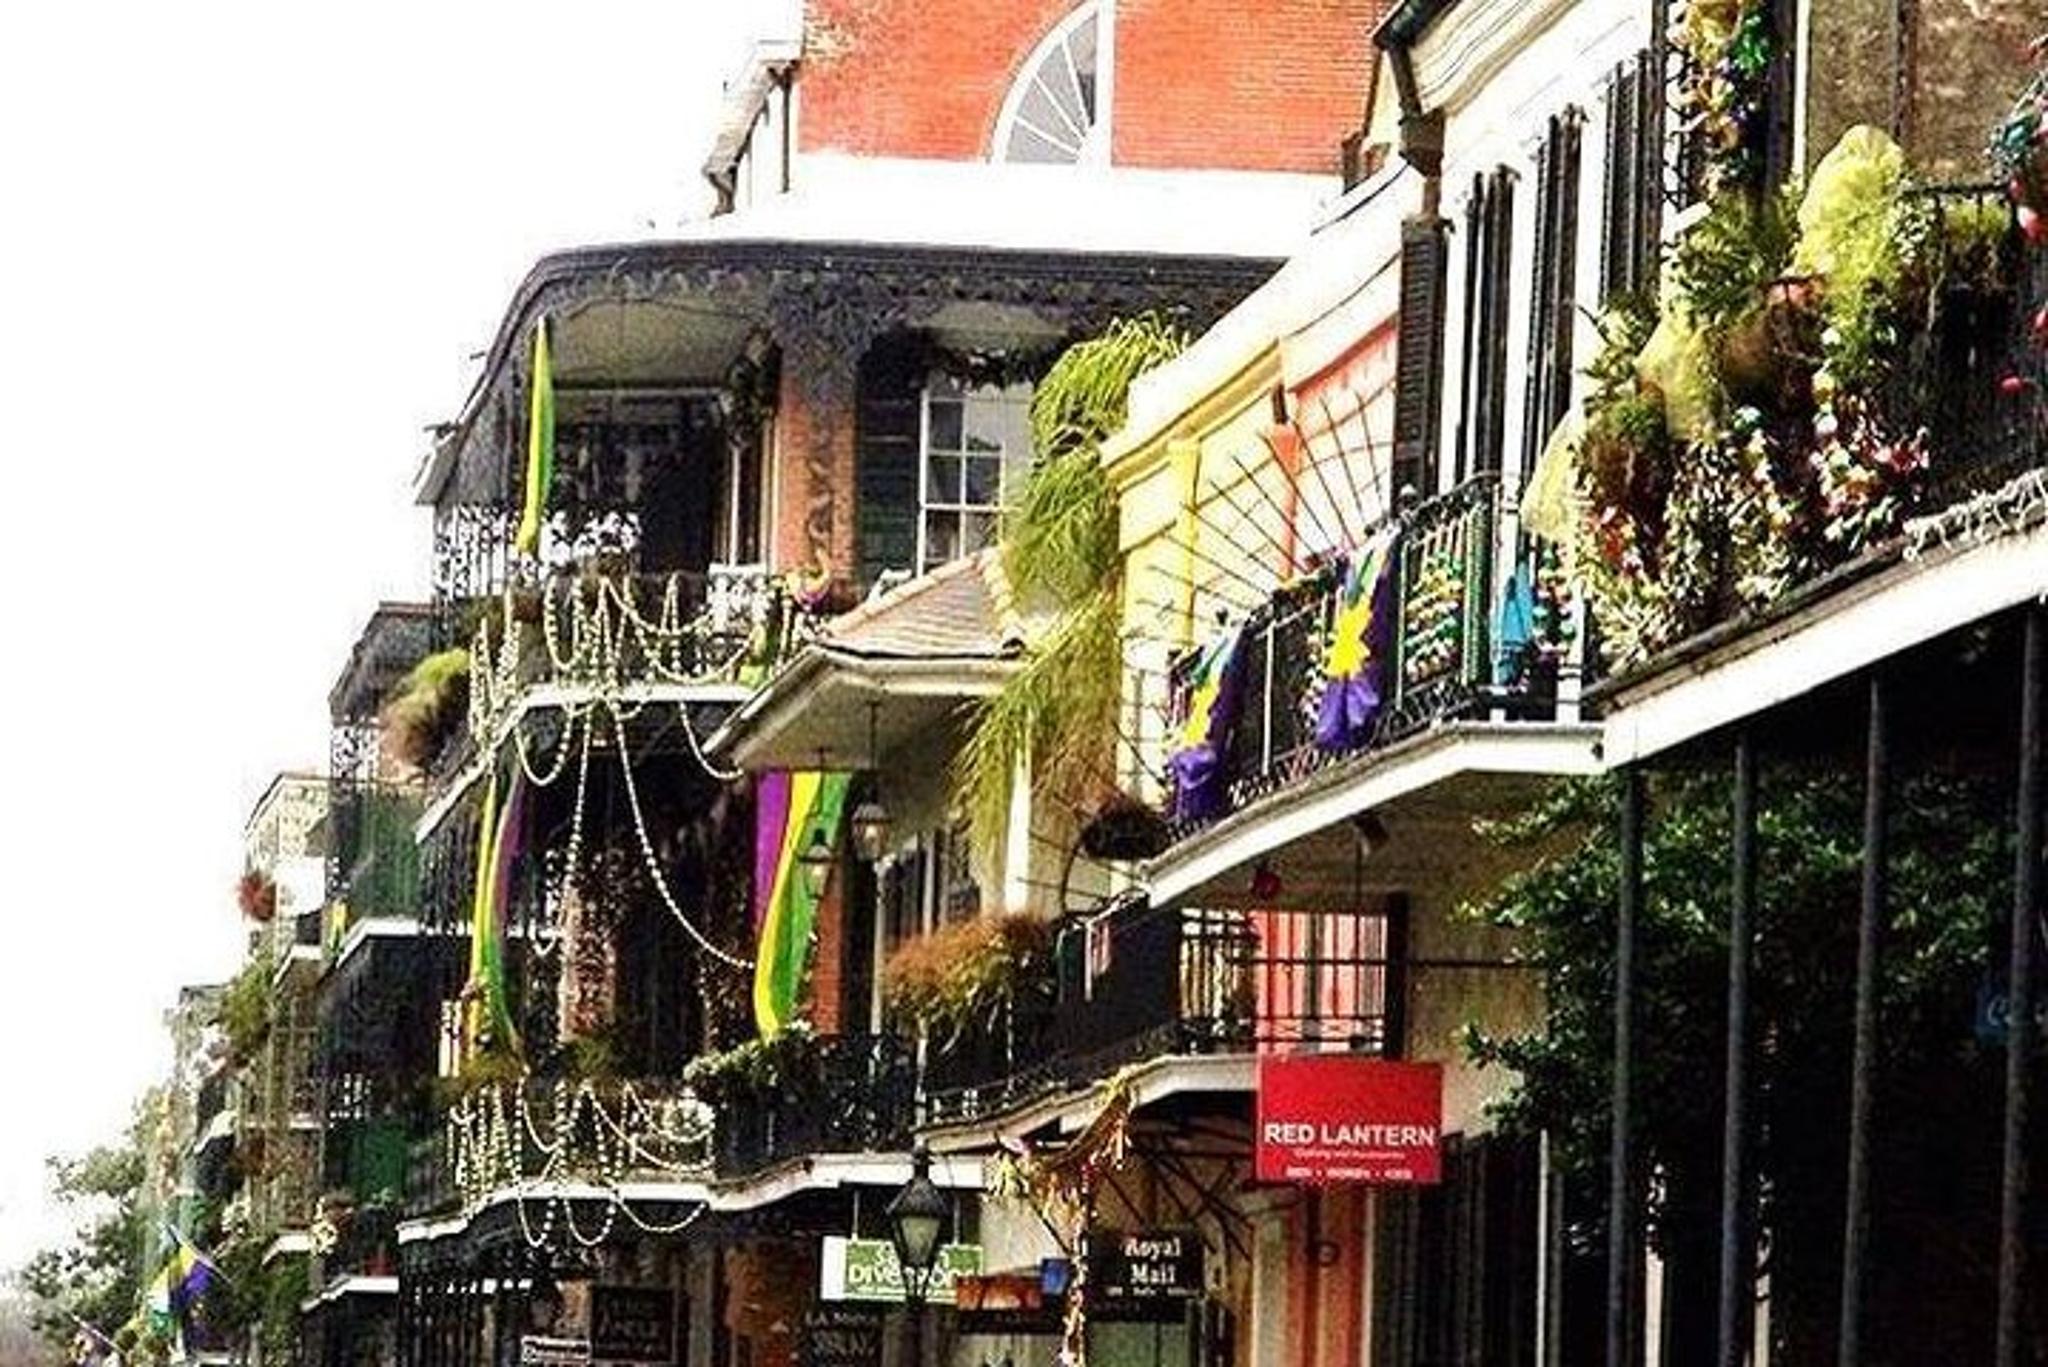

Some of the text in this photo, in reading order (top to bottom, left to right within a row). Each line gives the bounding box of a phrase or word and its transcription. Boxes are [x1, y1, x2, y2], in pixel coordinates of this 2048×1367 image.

[1264, 1122, 1435, 1147] RED LANTERN
[1123, 1237, 1181, 1262] Royal
[1130, 1263, 1176, 1285] Mail
